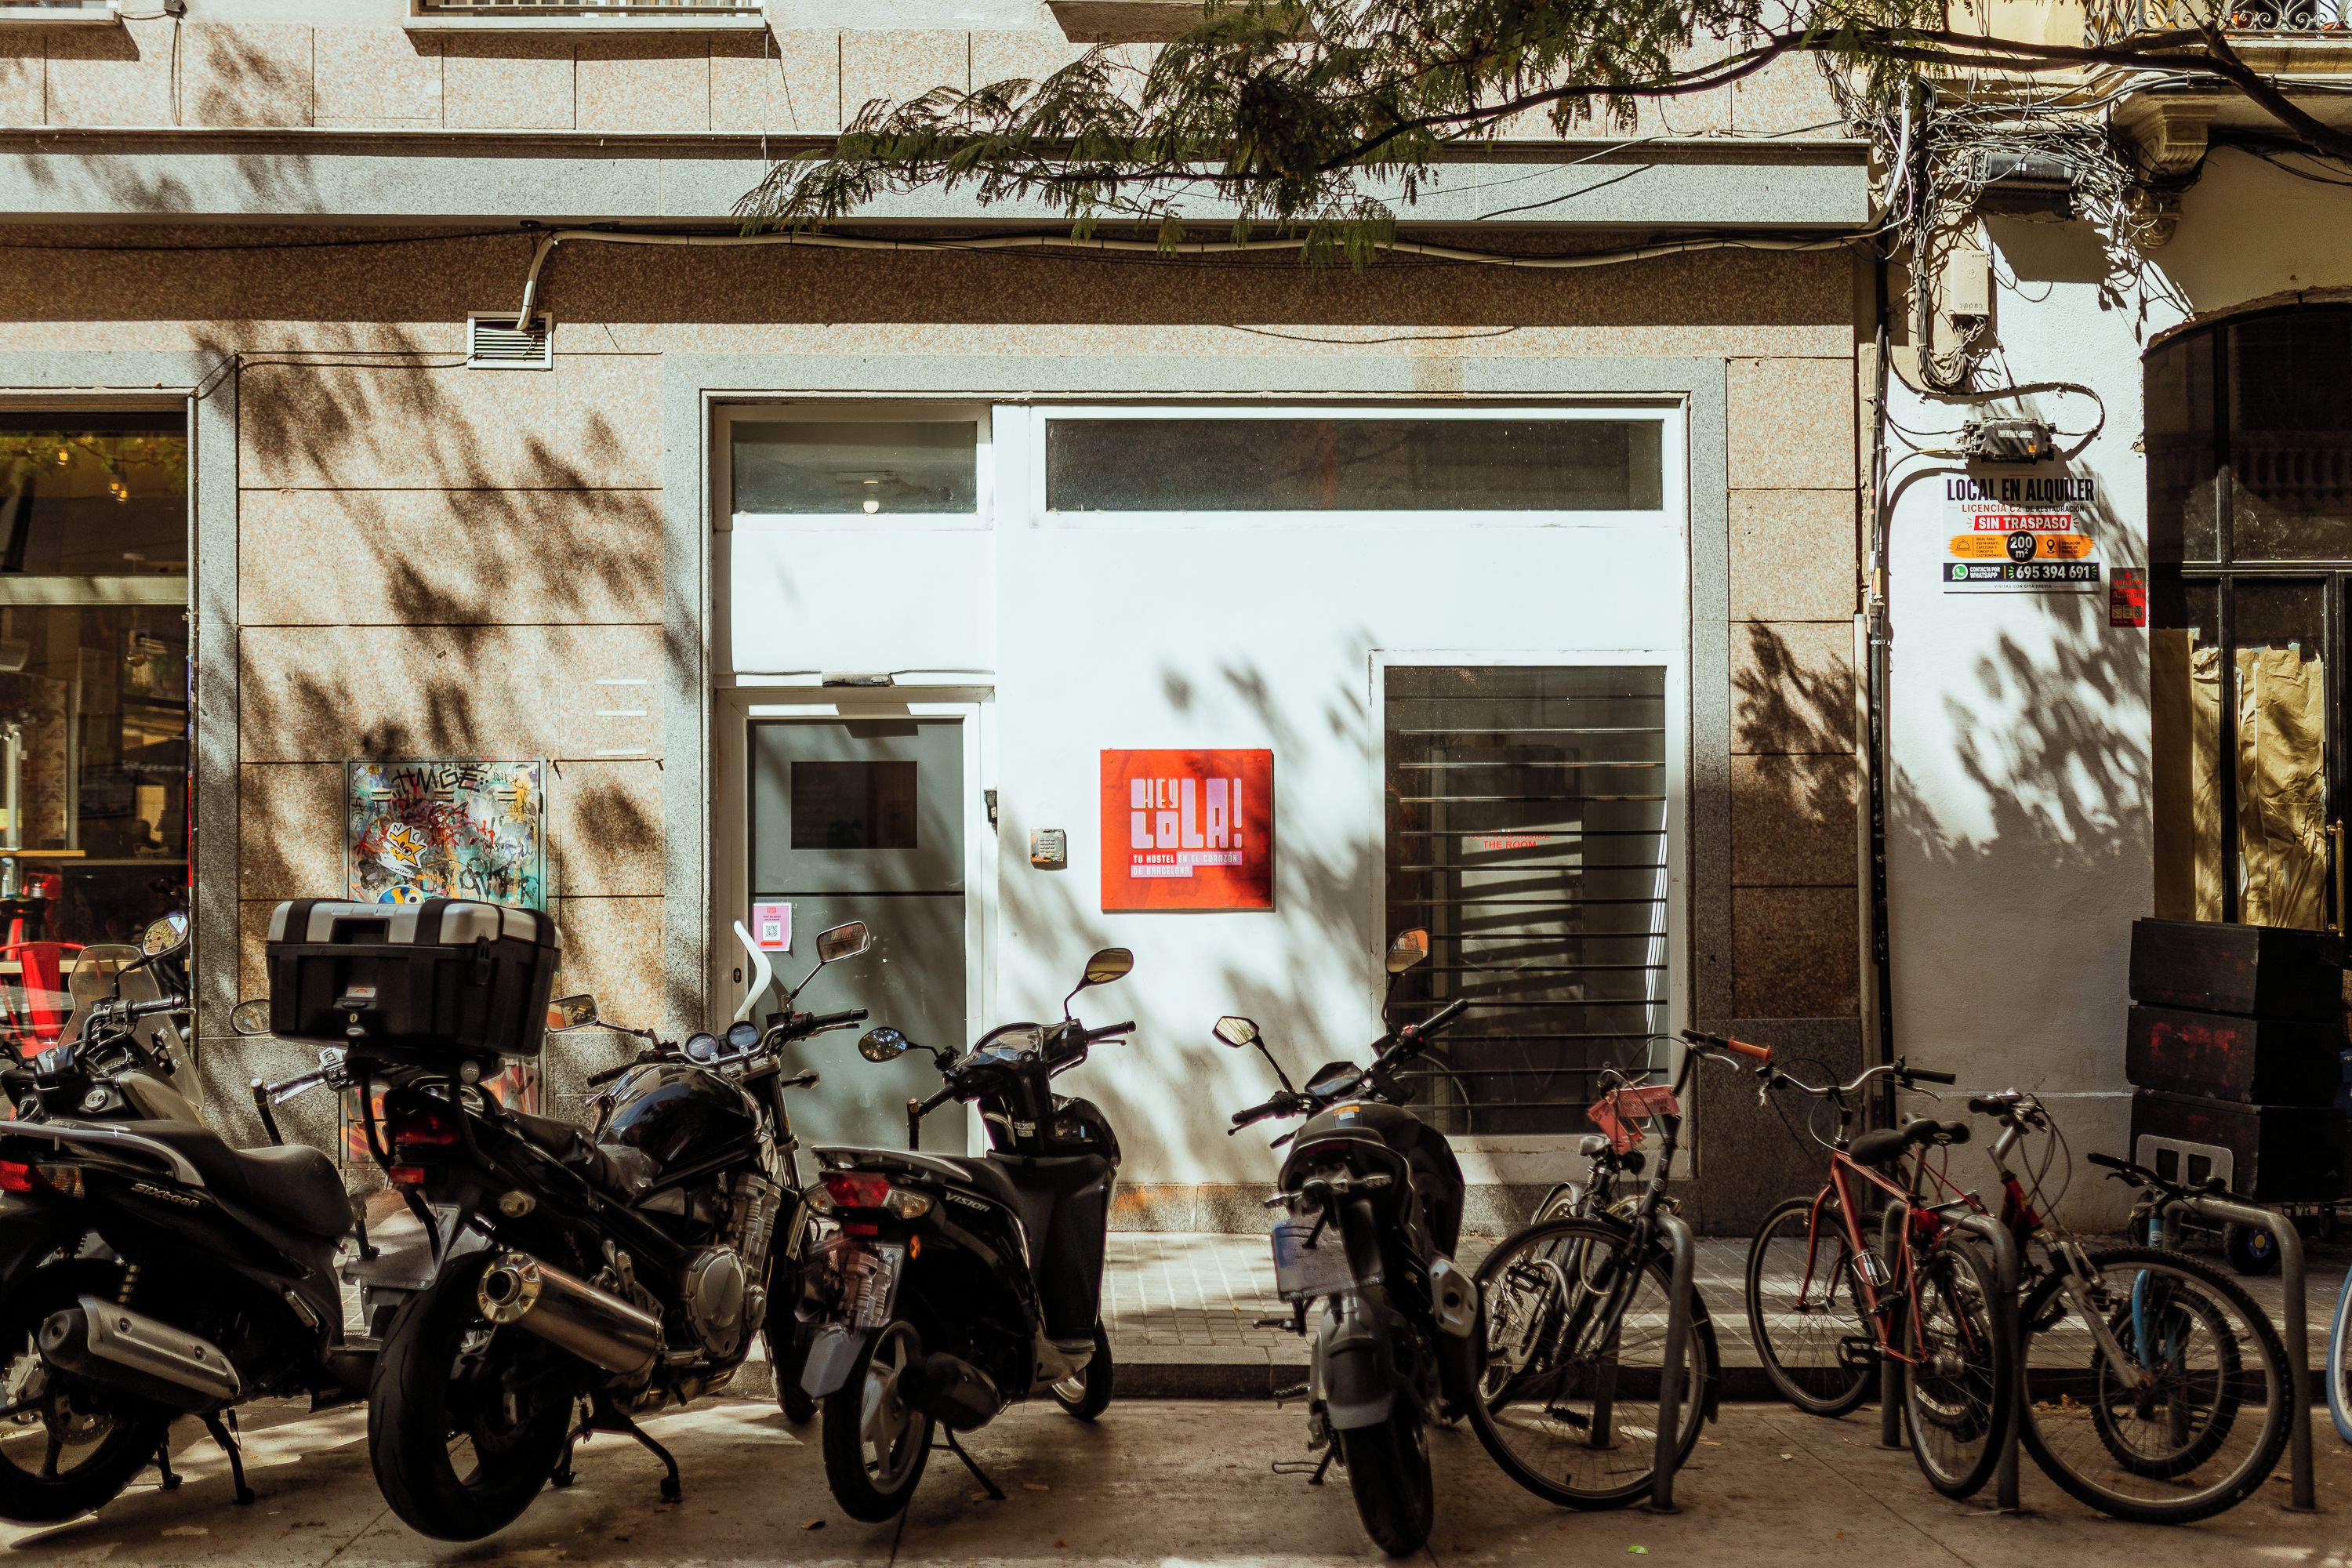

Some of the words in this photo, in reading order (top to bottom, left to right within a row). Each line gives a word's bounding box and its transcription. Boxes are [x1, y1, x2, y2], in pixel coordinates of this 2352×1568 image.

[1947, 478, 1998, 501] LOCAL
[2002, 478, 2020, 501] EN
[2025, 478, 2095, 503] ALQUILER
[2036, 504, 2085, 513] RESTAURACIÓN
[1978, 517, 1999, 529] SIN
[2003, 517, 2067, 529] TRASPASO
[2010, 536, 2033, 549] 200
[2016, 566, 2040, 579] 695
[2042, 566, 2066, 579] 394
[2069, 566, 2089, 579] 691
[1131, 779, 1178, 809] HEY
[1131, 779, 1242, 848] LOLA!
[1483, 840, 1502, 849] THE
[1505, 840, 1537, 849] ROOM
[1133, 855, 1143, 864] TU
[1146, 855, 1174, 864] HOSTEL
[1178, 855, 1188, 863] EN
[1192, 855, 1199, 863] EL
[946, 1192, 991, 1212] VISION
